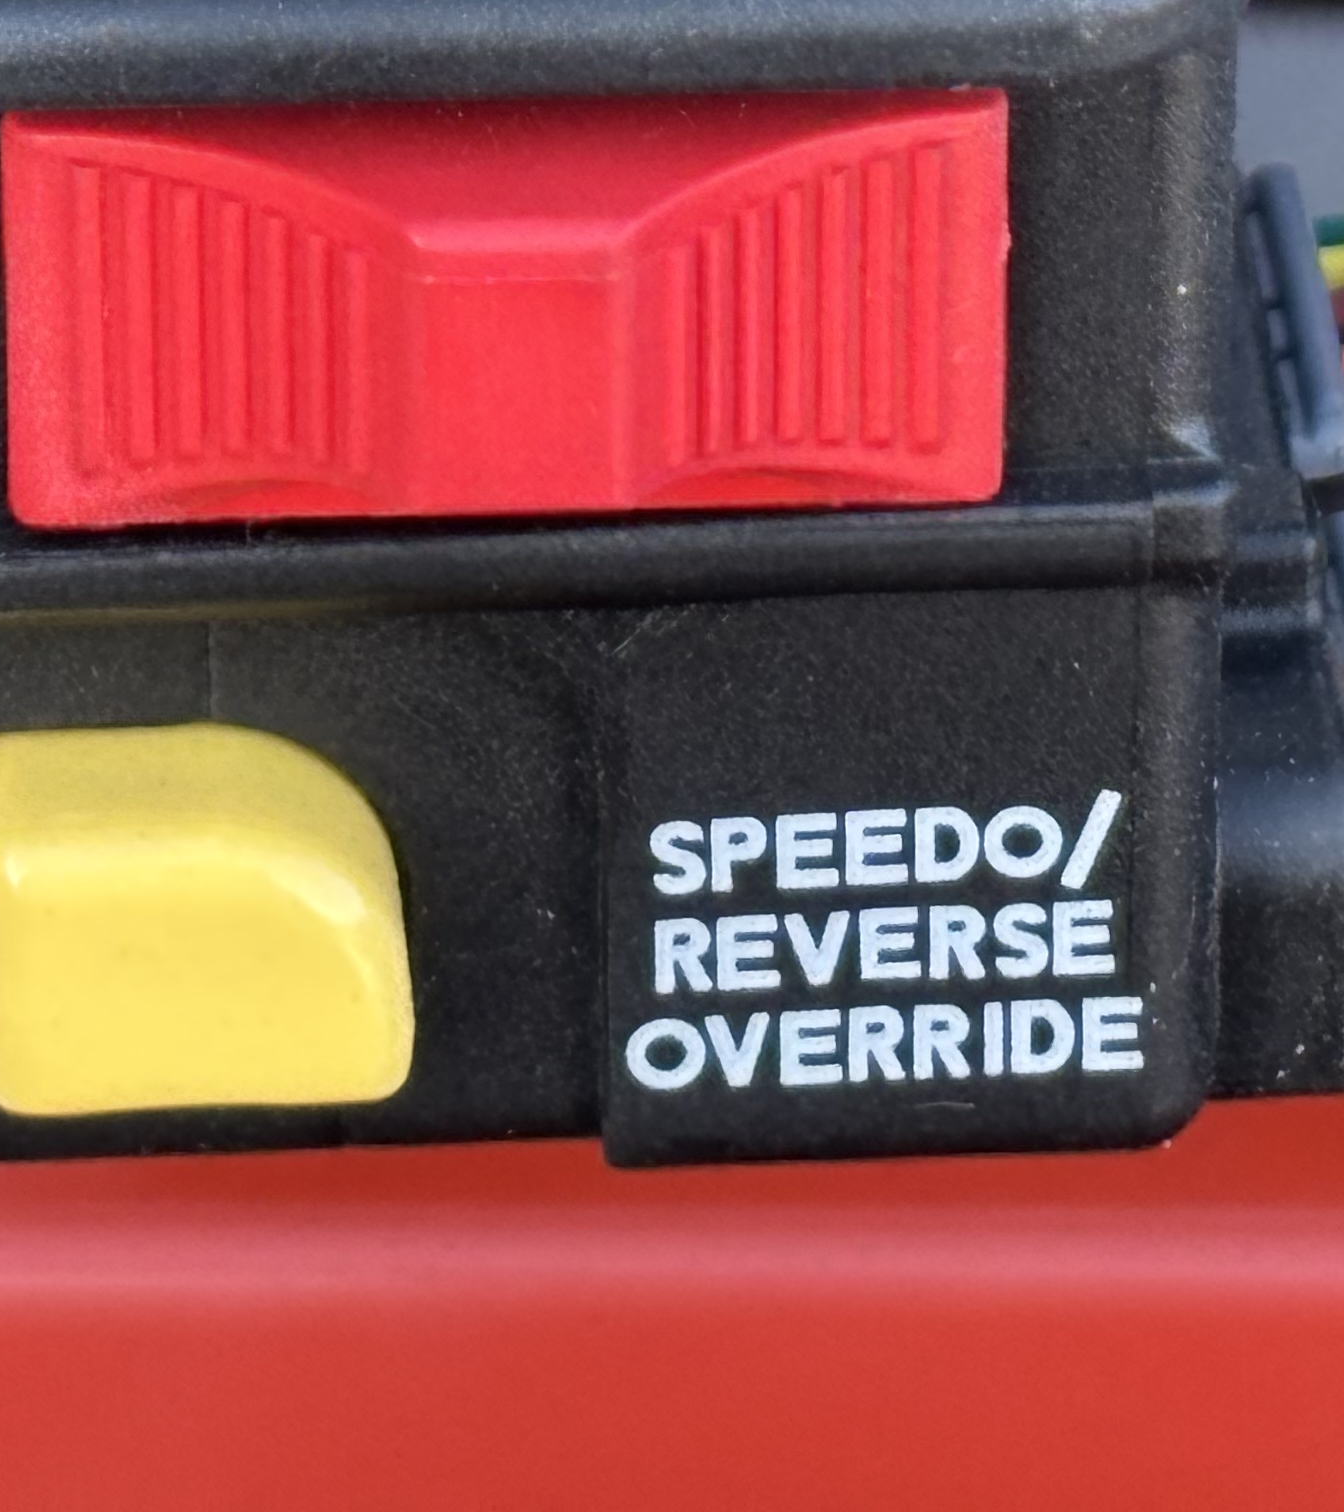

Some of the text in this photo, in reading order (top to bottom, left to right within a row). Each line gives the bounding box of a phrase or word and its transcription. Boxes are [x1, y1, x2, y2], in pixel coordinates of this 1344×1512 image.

[649, 789, 1123, 895] SPEEDO/
[653, 899, 1116, 995] REVERSE
[625, 996, 1145, 1090] OVERRIDE
